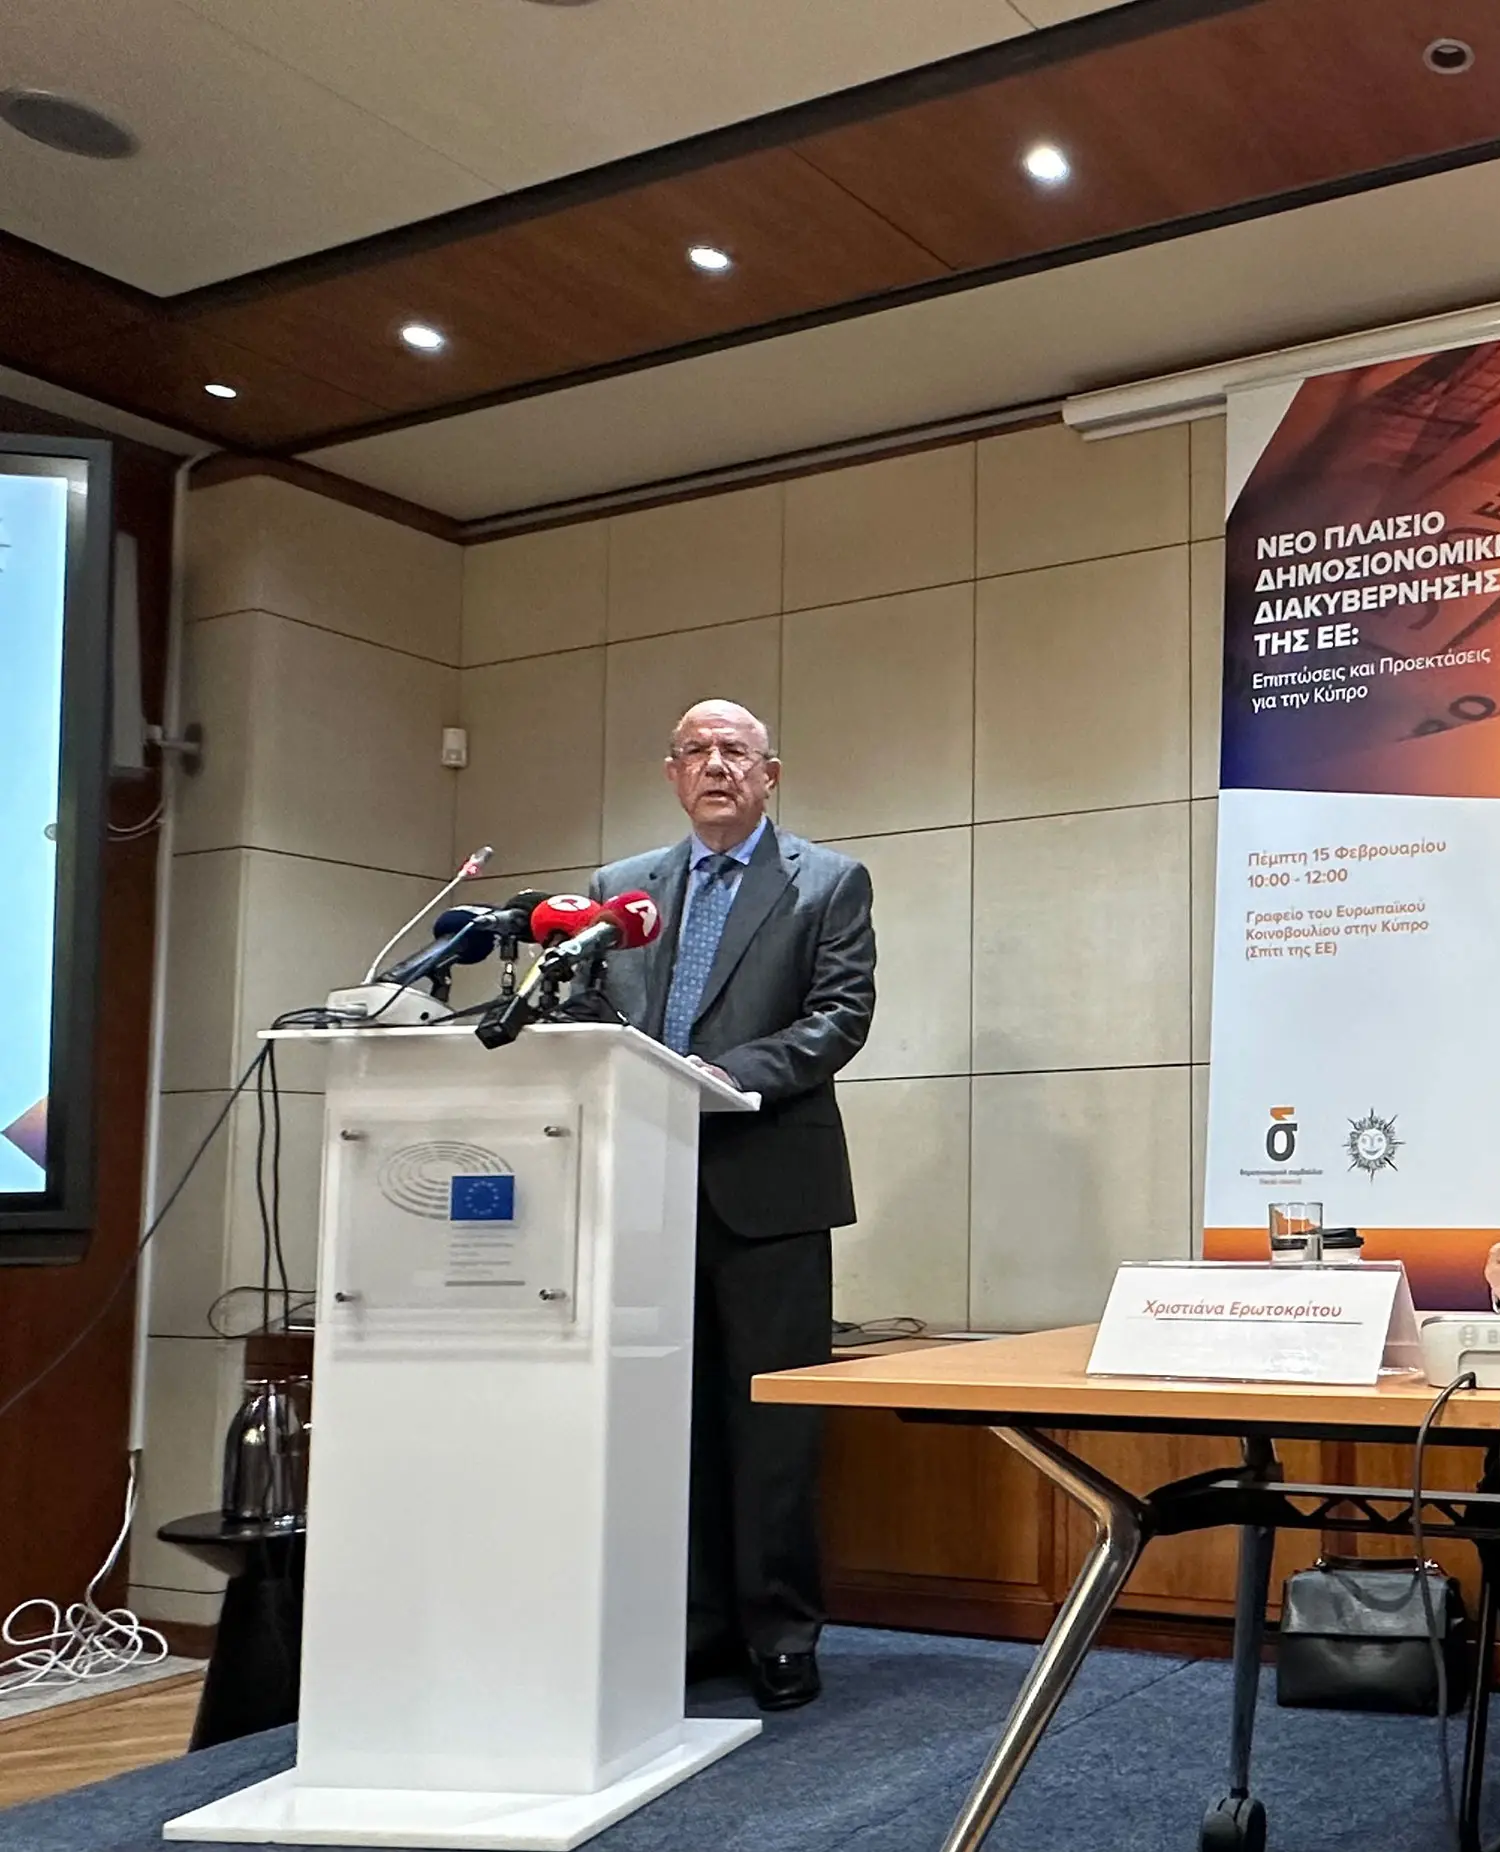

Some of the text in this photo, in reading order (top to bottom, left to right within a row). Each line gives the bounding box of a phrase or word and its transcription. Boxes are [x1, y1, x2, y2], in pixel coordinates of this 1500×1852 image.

[1257, 510, 1445, 560] ΝΕΟ ΠΛΑΙΣΙΟ
[1254, 569, 1500, 625] ΔΙΑΚΥΒΕΡΝΗΣΗΣ
[1255, 624, 1360, 656] ΤΗΣ ΕΕ:
[1252, 647, 1491, 690] Επιπτώσεις και Προεκτάσεις
[1251, 683, 1368, 713] για την Κύπρο
[1248, 837, 1447, 868] Πέμπτη 15 Φεβρουαρίου
[1247, 872, 1291, 889] 10:00
[1304, 868, 1348, 885] 12:00
[1246, 898, 1425, 925] Γραφείο του Ευρωπαϊκού
[1245, 917, 1429, 942] Κοινοβουλίου στην Κύπρο
[1286, 944, 1311, 959] της
[1314, 941, 1338, 957] ΕΕ)
[1142, 1299, 1342, 1319] Χριστιάνα Ερωτοκρίτου
